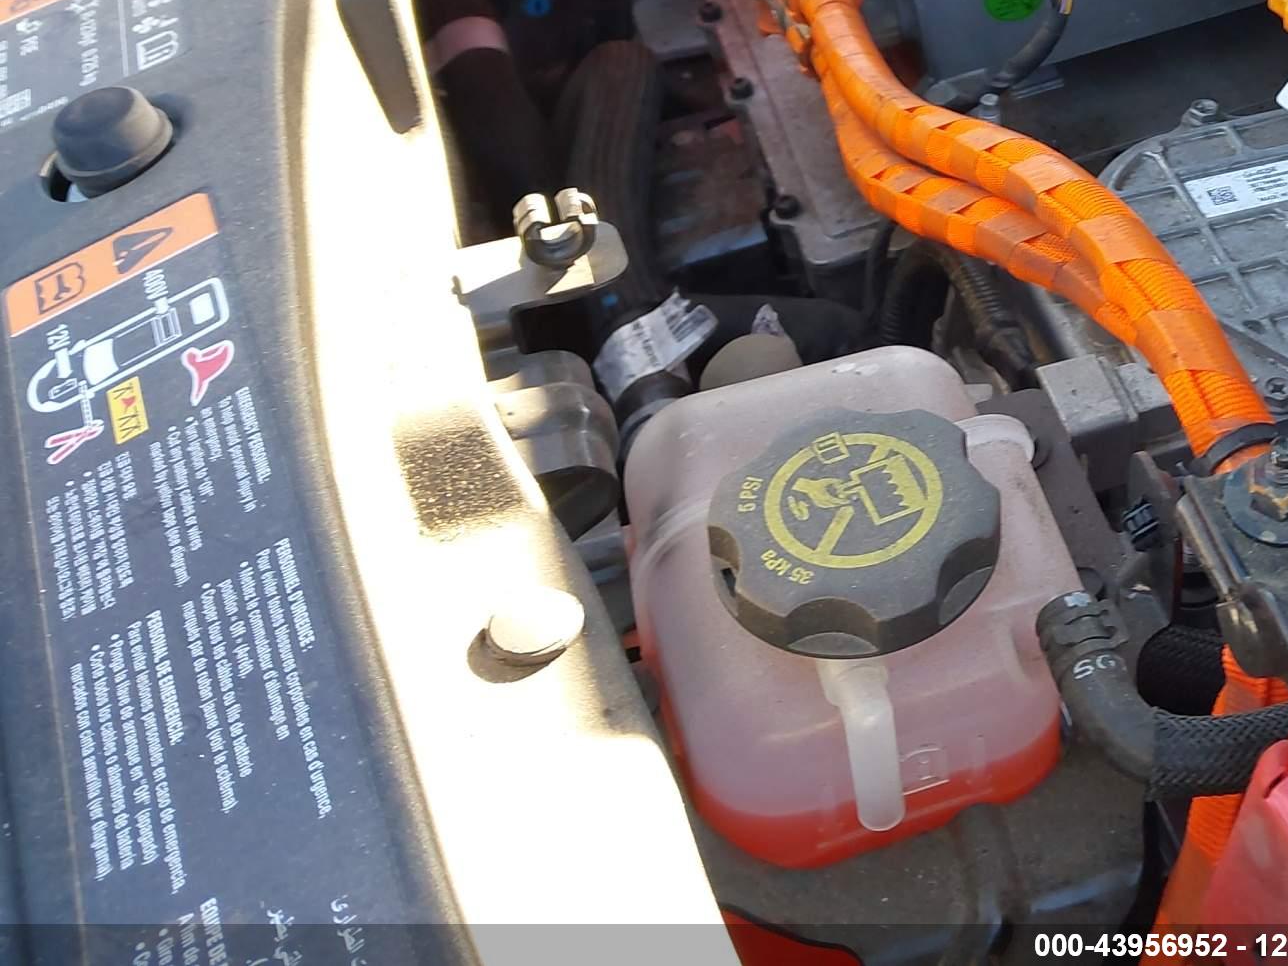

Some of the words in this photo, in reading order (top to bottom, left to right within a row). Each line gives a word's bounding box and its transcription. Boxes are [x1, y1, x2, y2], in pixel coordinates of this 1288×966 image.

[143, 268, 168, 300] 400V
[46, 323, 71, 350] 12V
[217, 394, 232, 409] To
[219, 404, 236, 425] help
[166, 430, 182, 448] Cut
[184, 419, 199, 442] Turn
[223, 423, 242, 446] avoid
[235, 386, 259, 434] EMERGENCY
[247, 432, 271, 484] PERSONNEL:
[149, 441, 168, 472] marked
[168, 445, 183, 463] any
[186, 438, 205, 470] ignition
[227, 444, 250, 480] personal
[152, 468, 169, 484] by
[172, 459, 189, 491] battery
[194, 466, 209, 480] to
[103, 491, 118, 503] 시
[154, 480, 173, 509] yellow
[236, 476, 254, 503] injury
[738, 476, 764, 500] PSI
[178, 488, 196, 517] cables
[242, 499, 258, 513] in
[161, 506, 177, 528] tape
[184, 515, 198, 527] or
[186, 525, 203, 551] wires
[255, 547, 271, 572] Pour
[761, 549, 790, 576] kPa
[238, 566, 257, 601] Mettez
[788, 566, 815, 585] 35
[200, 588, 218, 623] Couper
[245, 596, 261, 611] le
[274, 537, 300, 593] PERSONNEL
[287, 590, 315, 647] D'URGENCE
[181, 600, 202, 642] marqués
[216, 578, 239, 616] position
[228, 620, 247, 638] Off
[266, 595, 285, 627] toutes
[127, 620, 142, 646] Para
[146, 610, 168, 663] PERSONAL
[207, 620, 223, 645] tous
[248, 609, 273, 670] commutateur
[108, 639, 125, 673] Ponga
[130, 644, 147, 672] evitar
[186, 639, 204, 658] par
[212, 641, 227, 660] les
[274, 624, 296, 672] blessures
[89, 650, 106, 679] Corte
[113, 668, 129, 683] la
[154, 659, 172, 678] DE
[192, 657, 208, 673] du
[215, 658, 234, 692] câbles
[70, 662, 88, 711] marcados
[93, 676, 110, 707] todos
[115, 679, 131, 707] llave
[135, 669, 154, 713] lesiones
[196, 670, 213, 701] ruban
[222, 690, 236, 707] ou
[262, 669, 287, 726] d'allumage
[285, 671, 310, 727] corporelles
[76, 709, 91, 731] con
[97, 703, 112, 723] los
[119, 705, 135, 721] de
[158, 674, 184, 745] EMERGENCIA:
[199, 697, 219, 730] jaune
[225, 703, 242, 723] fils
[78, 729, 96, 757] cinta
[100, 721, 118, 756] cables
[121, 719, 141, 766] arranque
[140, 711, 164, 767] personales
[205, 727, 226, 753] (voir
[228, 721, 245, 738] de
[275, 724, 290, 741] en
[298, 725, 314, 742] en
[104, 754, 119, 765] o
[213, 749, 229, 765] le
[232, 734, 253, 778] batterie
[302, 740, 319, 762] cas
[82, 755, 102, 799] amarilla
[129, 764, 144, 782] en
[152, 766, 167, 783] en
[106, 763, 126, 814] alambres
[154, 780, 171, 808] caso
[307, 760, 332, 819] d'urgence,
[86, 796, 104, 820] (ver
[113, 812, 130, 830] de
[159, 807, 176, 824] de
[134, 807, 159, 865] (apagado)
[162, 823, 186, 894] emergencia,
[199, 897, 222, 943] EQUIPE
[207, 942, 227, 966] DE
